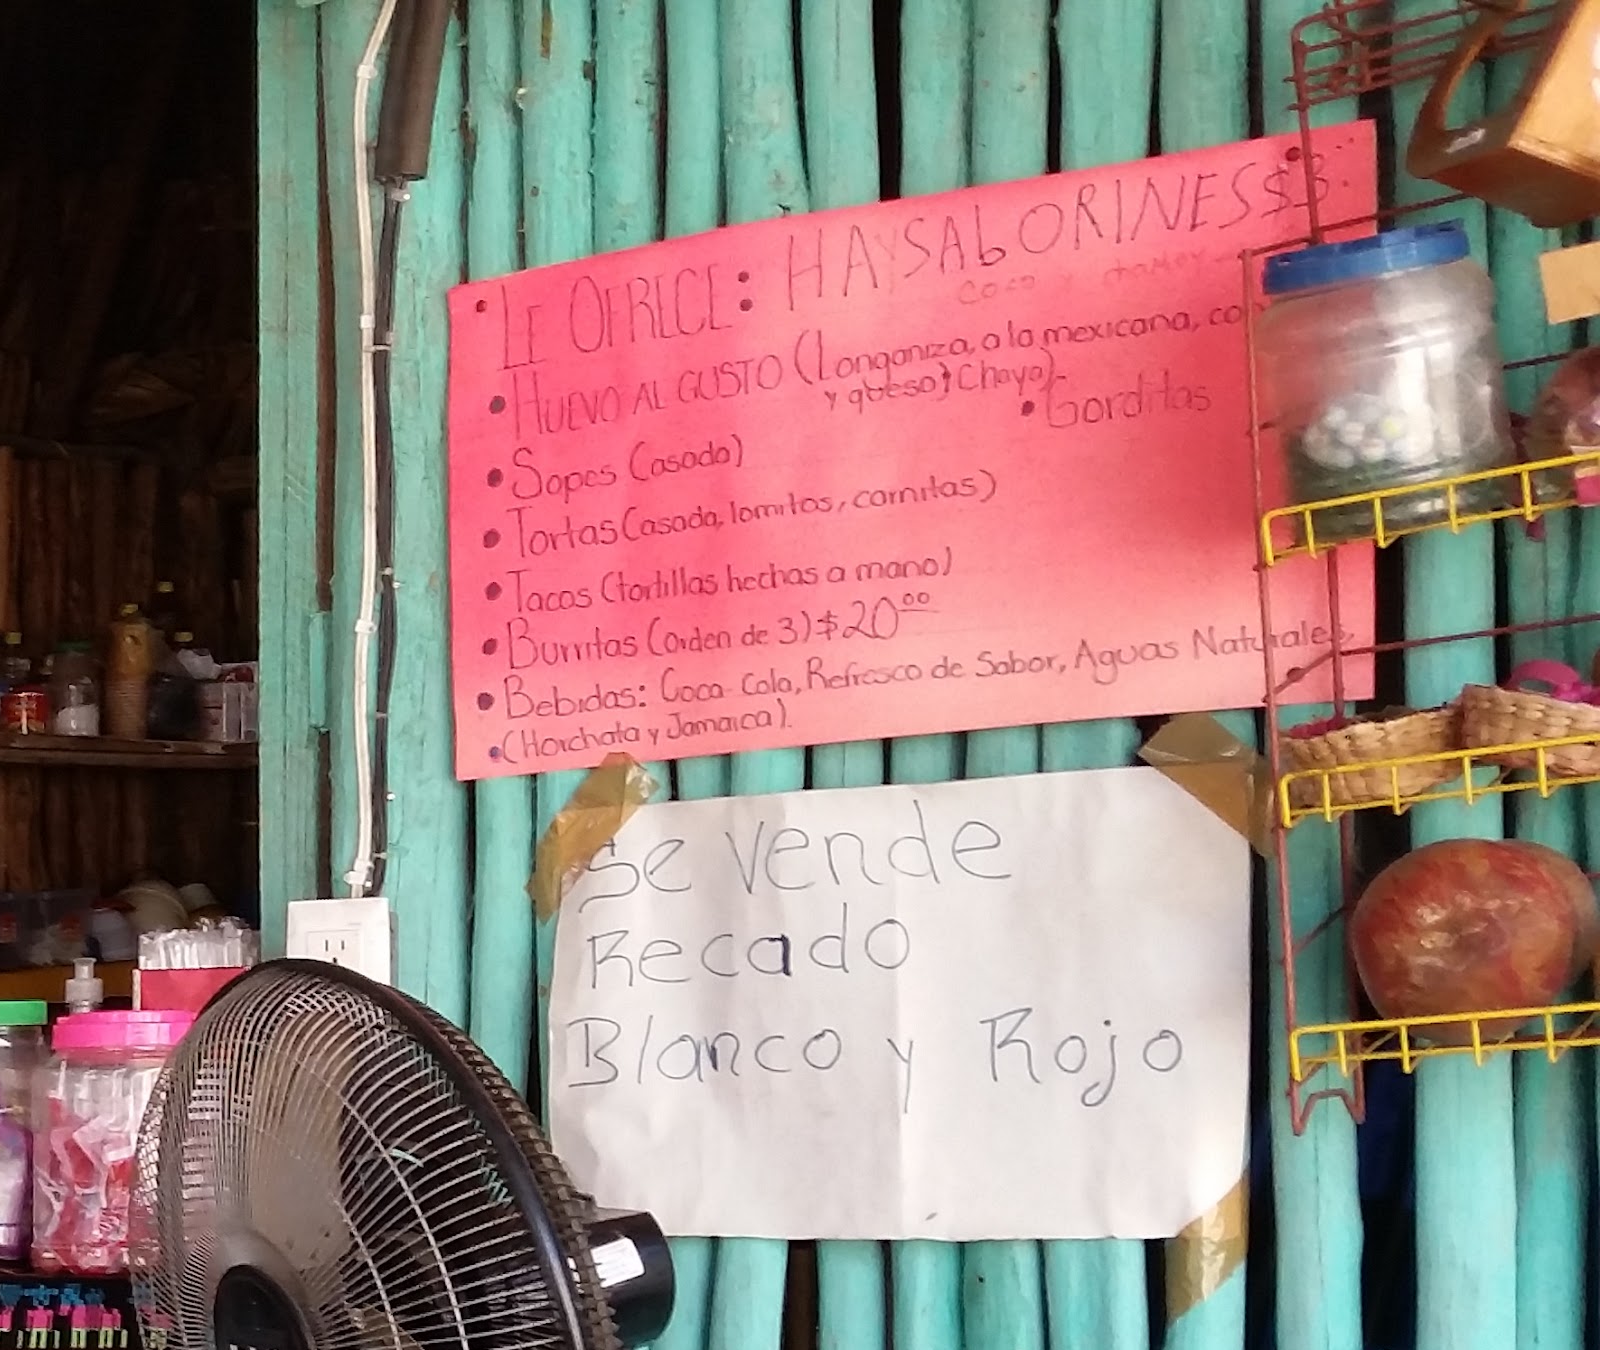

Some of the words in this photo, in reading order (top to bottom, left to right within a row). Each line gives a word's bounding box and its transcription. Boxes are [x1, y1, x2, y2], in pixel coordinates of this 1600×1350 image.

[497, 284, 548, 371] LE
[632, 380, 667, 415] AL
[678, 354, 783, 403] GUSTO
[981, 332, 1001, 351] a
[1007, 319, 1034, 349] la
[511, 446, 618, 504] Sopes
[629, 433, 744, 482] (asada)
[506, 504, 619, 559] Tortas
[852, 469, 998, 510] carnitas)
[506, 568, 594, 613] Tacos
[601, 565, 719, 603] (tortillas
[726, 562, 819, 593] hechas
[826, 564, 846, 585] a
[855, 546, 953, 583] mano)
[740, 623, 770, 646] de
[503, 673, 647, 721] Bebidas:
[806, 656, 924, 691] Refresco
[931, 655, 966, 679] de
[1073, 637, 1181, 686] Aguas
[647, 727, 660, 746] y
[586, 901, 911, 990] Recado
[567, 1013, 843, 1089] Blanco
[886, 1036, 915, 1114] y
[979, 1006, 1184, 1108] Rojo
